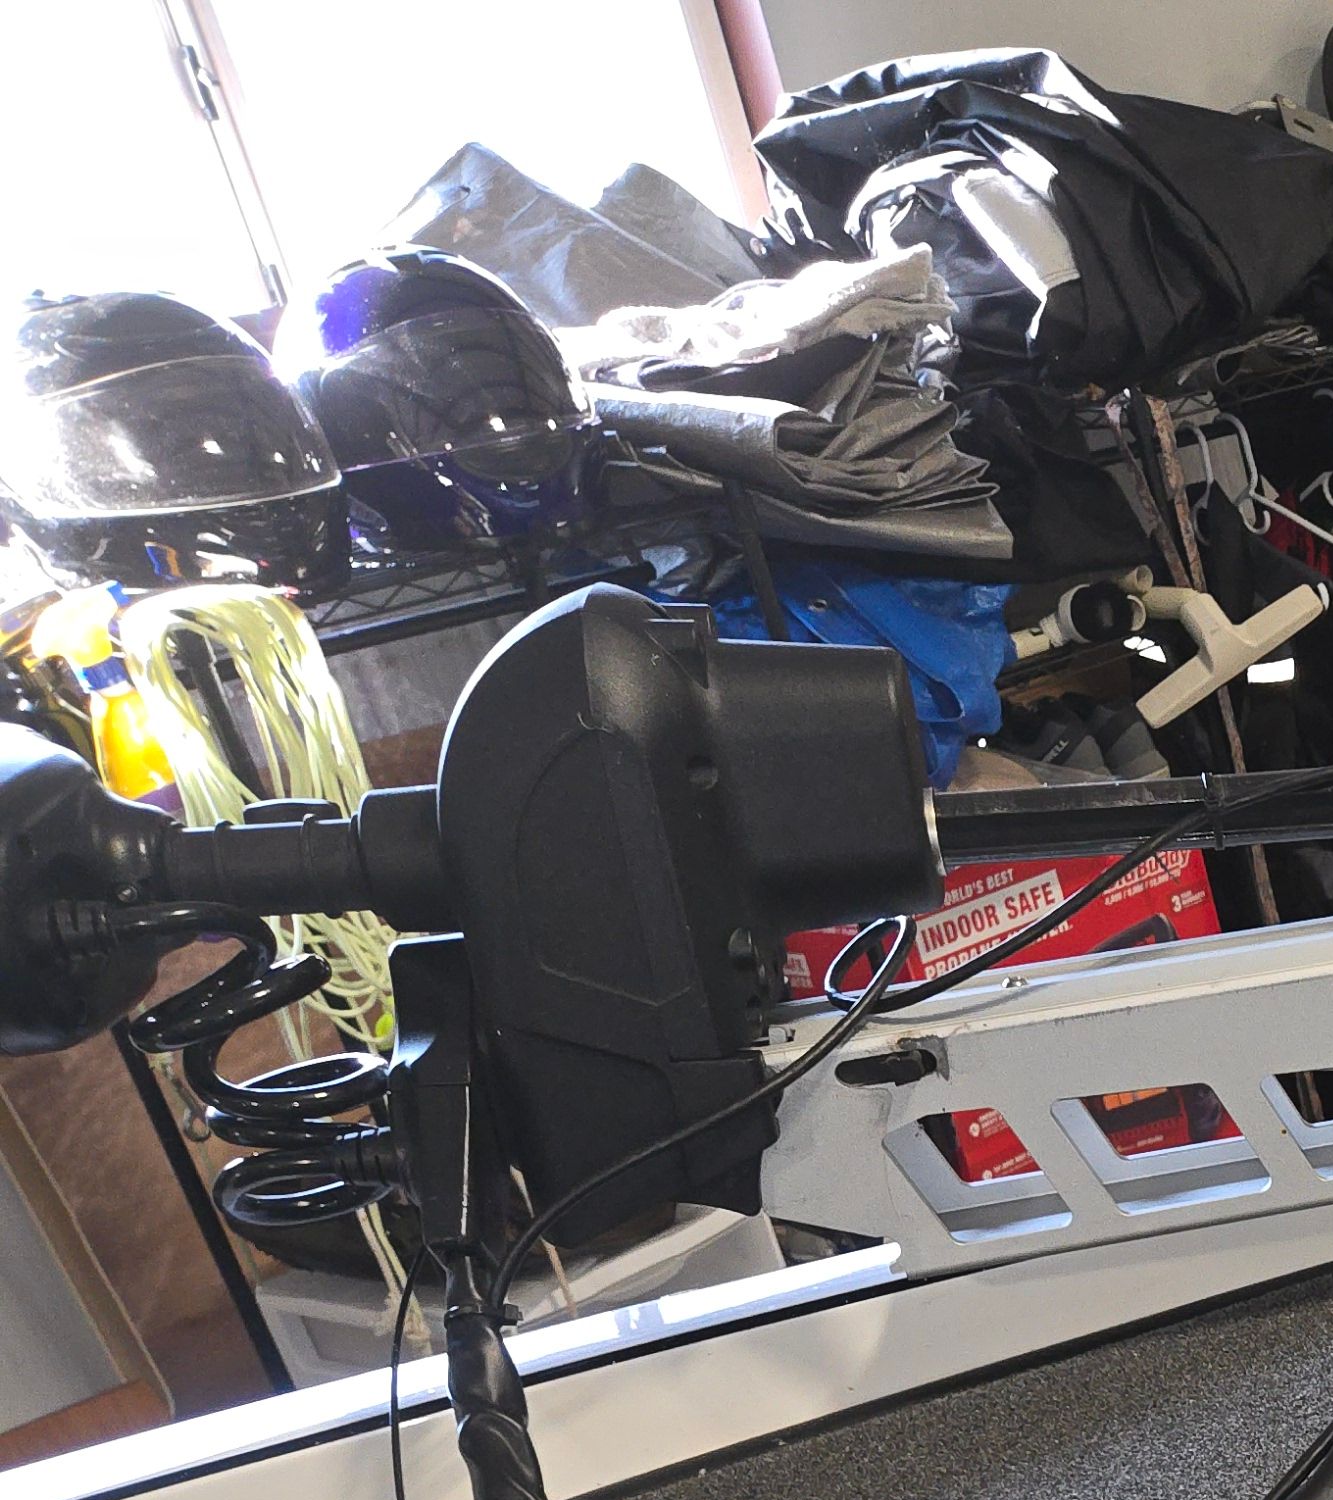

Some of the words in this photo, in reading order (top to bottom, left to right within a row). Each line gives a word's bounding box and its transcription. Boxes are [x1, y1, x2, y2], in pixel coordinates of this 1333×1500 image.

[944, 879, 985, 906] ORLD'S
[986, 868, 1014, 890] BEST
[1171, 895, 1182, 913] 3
[920, 903, 1000, 953] INDOOR
[1004, 881, 1056, 920] SAFE
